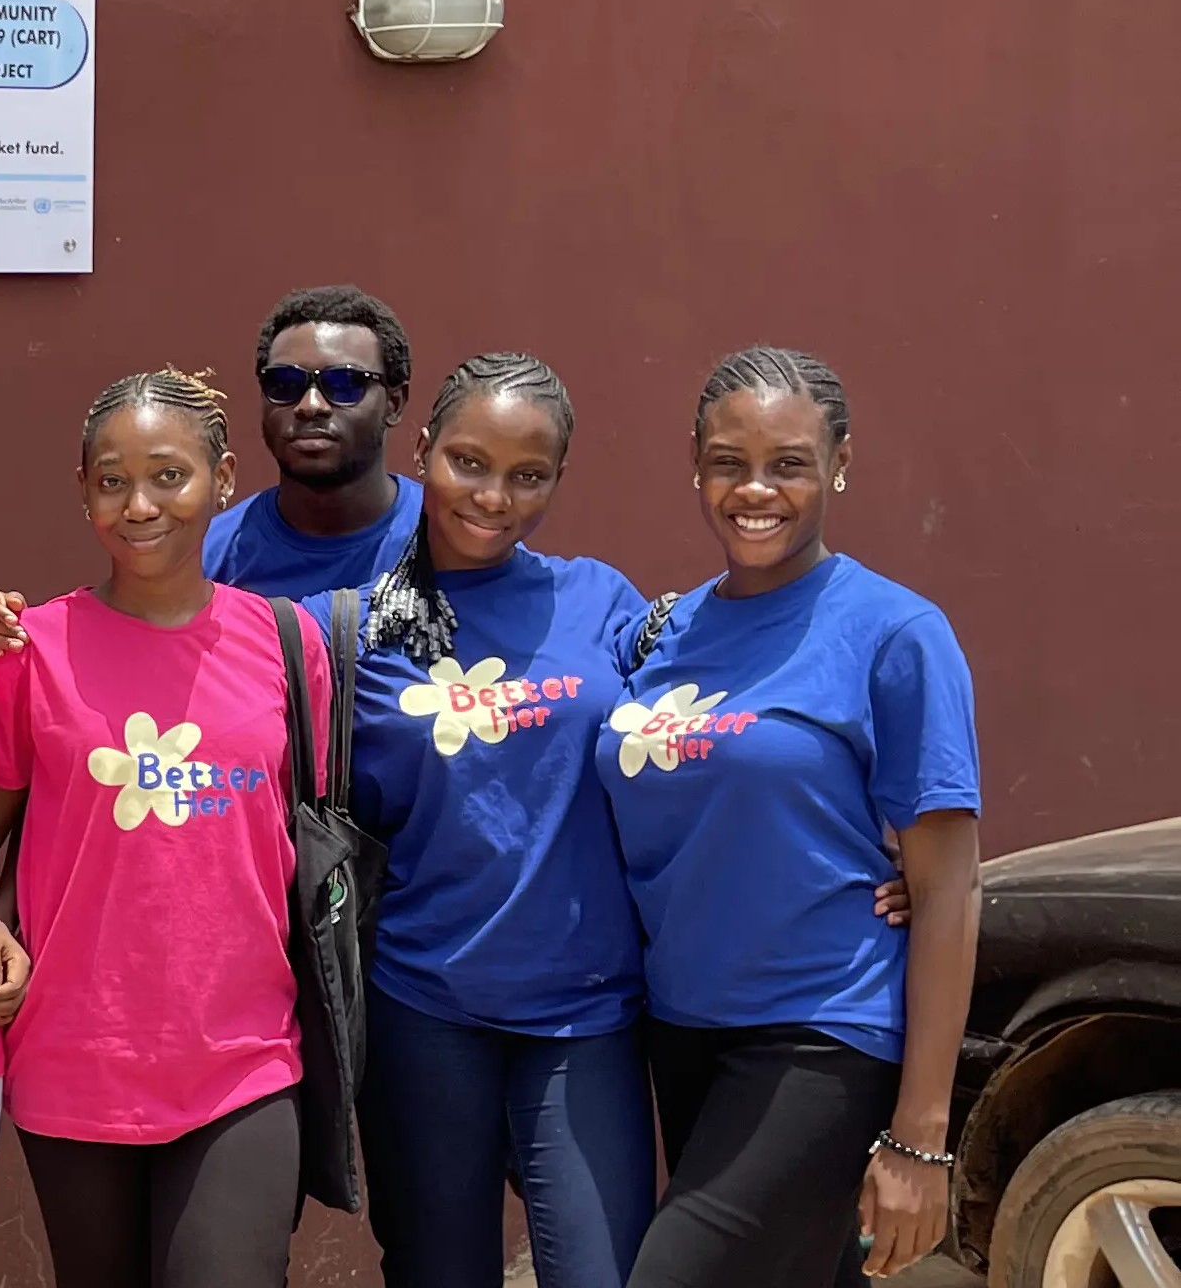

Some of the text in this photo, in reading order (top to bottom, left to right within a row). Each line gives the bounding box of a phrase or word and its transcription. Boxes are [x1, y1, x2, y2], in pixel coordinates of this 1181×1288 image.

[11, 29, 61, 49] (CART)
[25, 140, 64, 155] fund.
[447, 675, 583, 713] Better
[490, 705, 552, 734] Her
[641, 711, 759, 736] Better
[665, 734, 714, 764] Her
[136, 752, 266, 792] Better
[173, 790, 232, 818] Her
